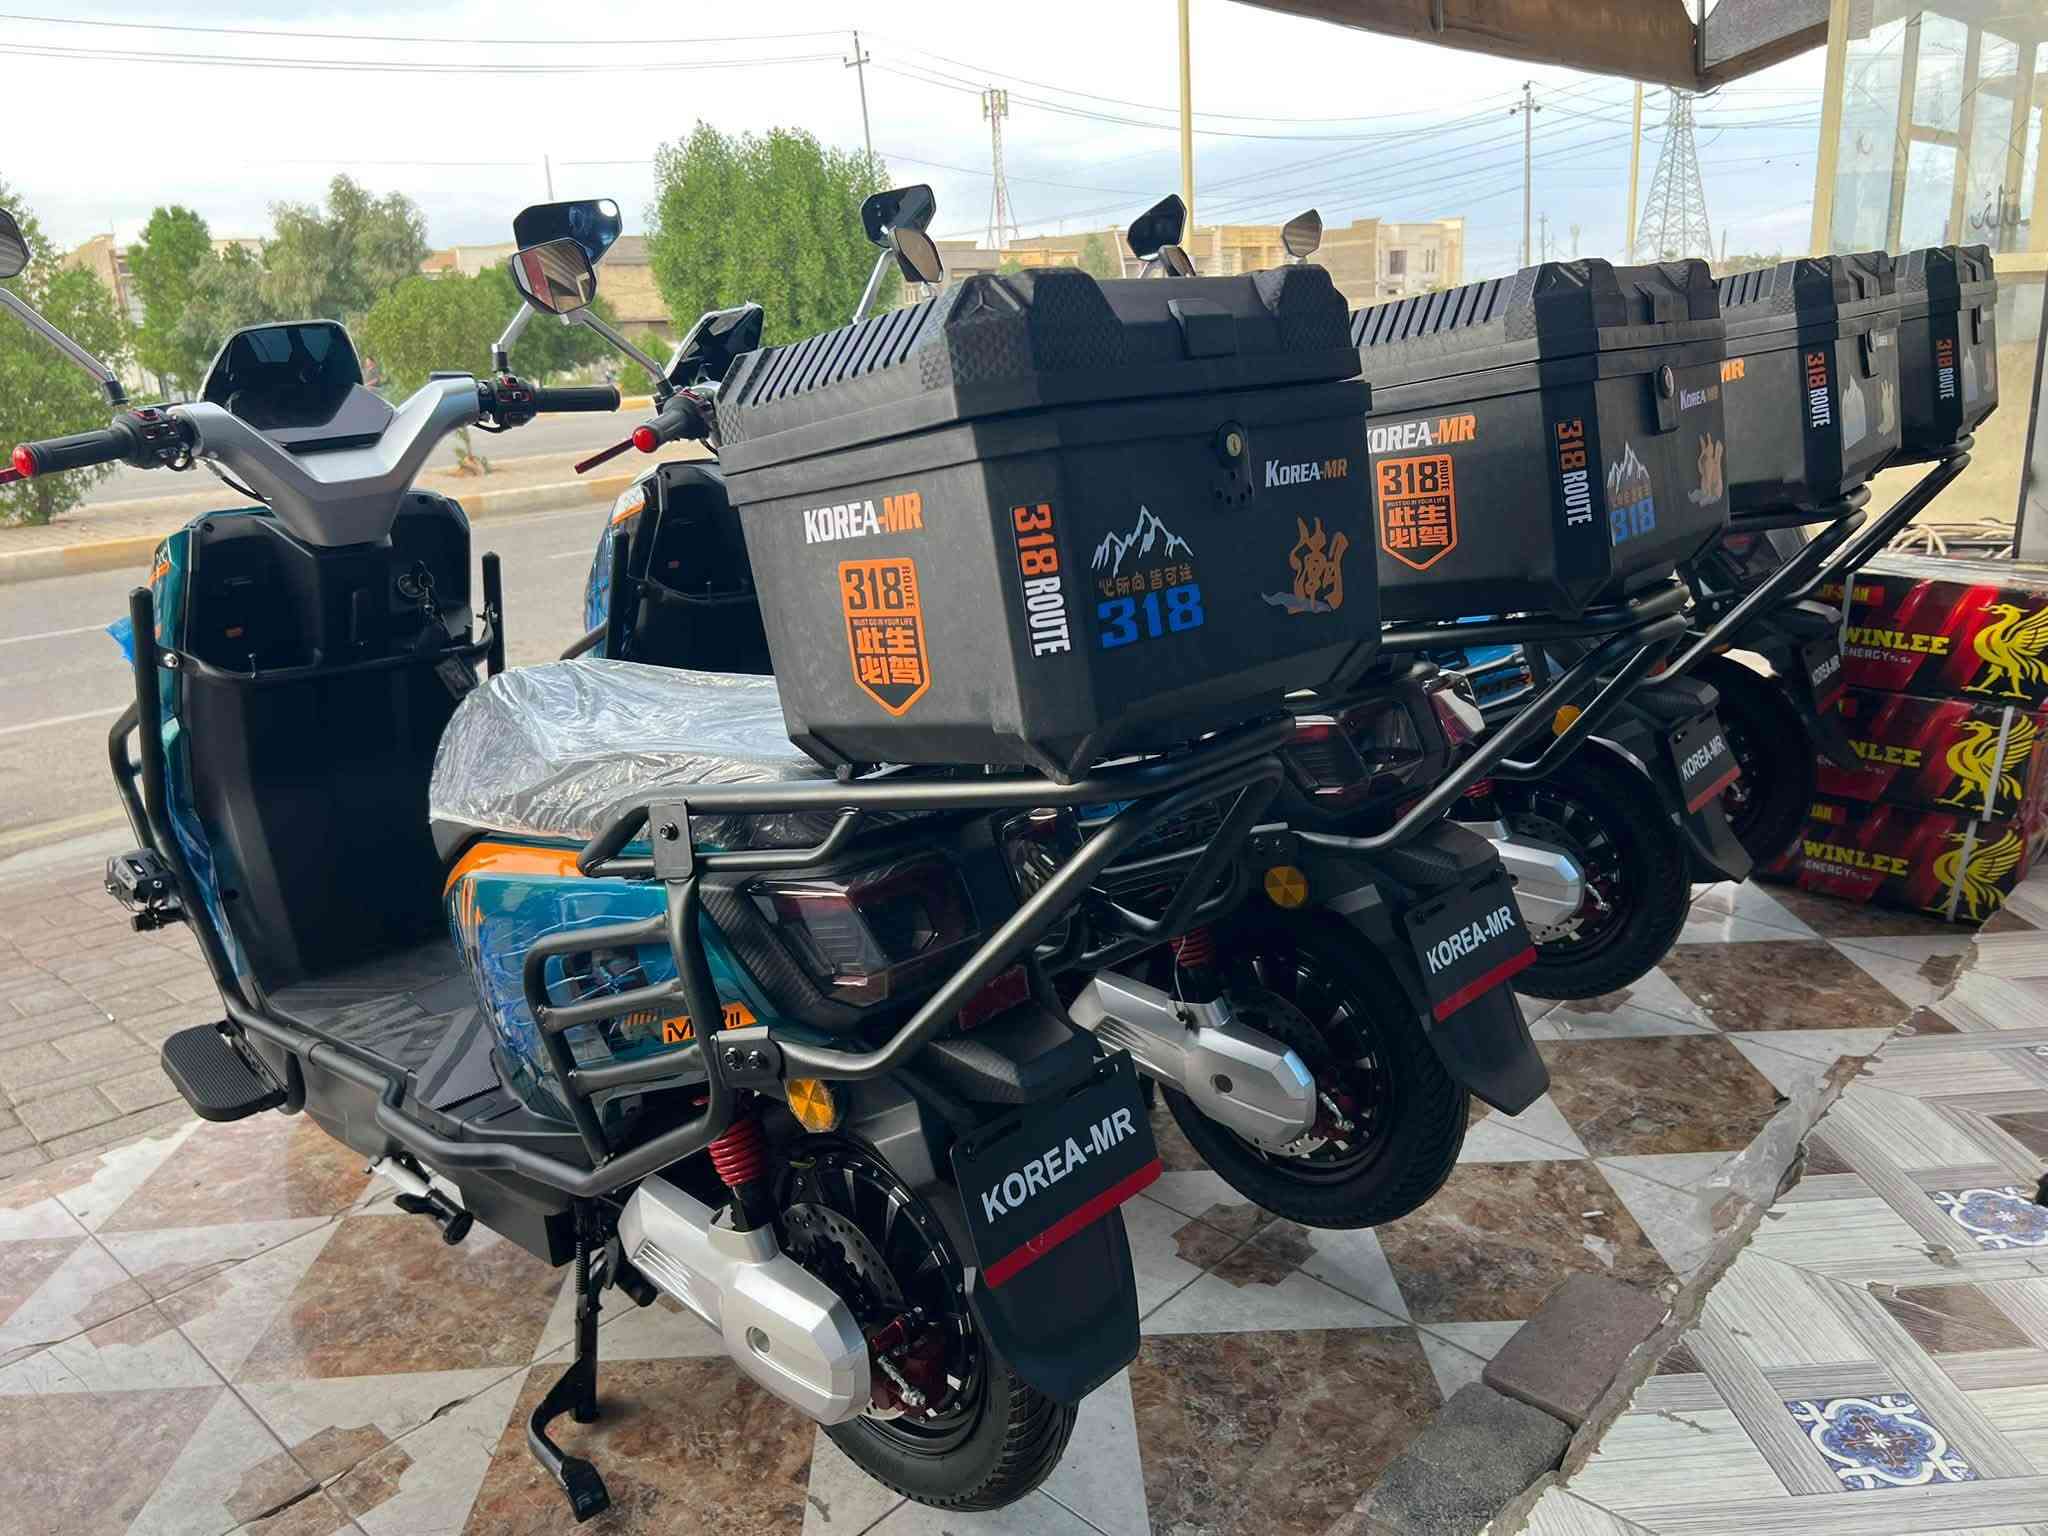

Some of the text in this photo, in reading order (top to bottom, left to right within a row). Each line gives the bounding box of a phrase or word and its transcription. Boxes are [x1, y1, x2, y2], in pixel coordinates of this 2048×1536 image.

[1807, 351, 1831, 428] 318 ROUTE
[1383, 461, 1439, 496] 318
[1440, 460, 1450, 491] ROUTE
[1556, 420, 1592, 526] 318 ROUTE
[803, 491, 924, 544] KOREA-MR
[845, 566, 904, 610] 318
[901, 565, 915, 608] ROUTE
[1013, 504, 1072, 657] 318 ROUTE
[1097, 583, 1204, 650] 318
[1681, 735, 1726, 781] KOREA-MR
[1803, 839, 1908, 876] WINLEE
[1426, 905, 1516, 975] KOREA-MR
[981, 1107, 1136, 1224] KOREA-MR
